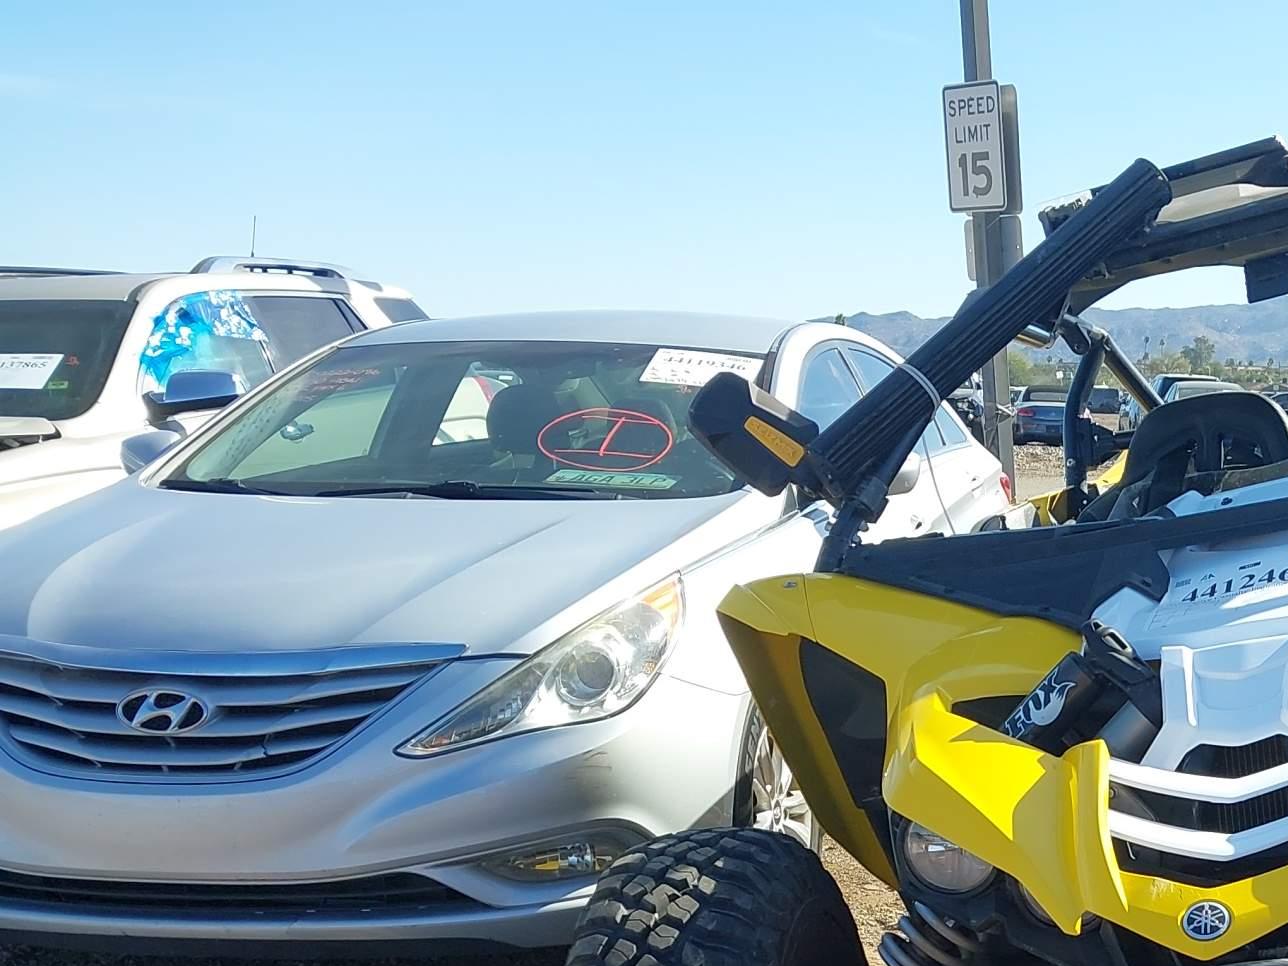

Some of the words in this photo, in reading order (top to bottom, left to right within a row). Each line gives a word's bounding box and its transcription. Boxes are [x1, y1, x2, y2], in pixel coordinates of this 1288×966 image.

[948, 95, 995, 117] SPEED
[954, 123, 991, 144] LIMIT
[958, 151, 993, 198] 15
[1004, 666, 1068, 739] FOX
